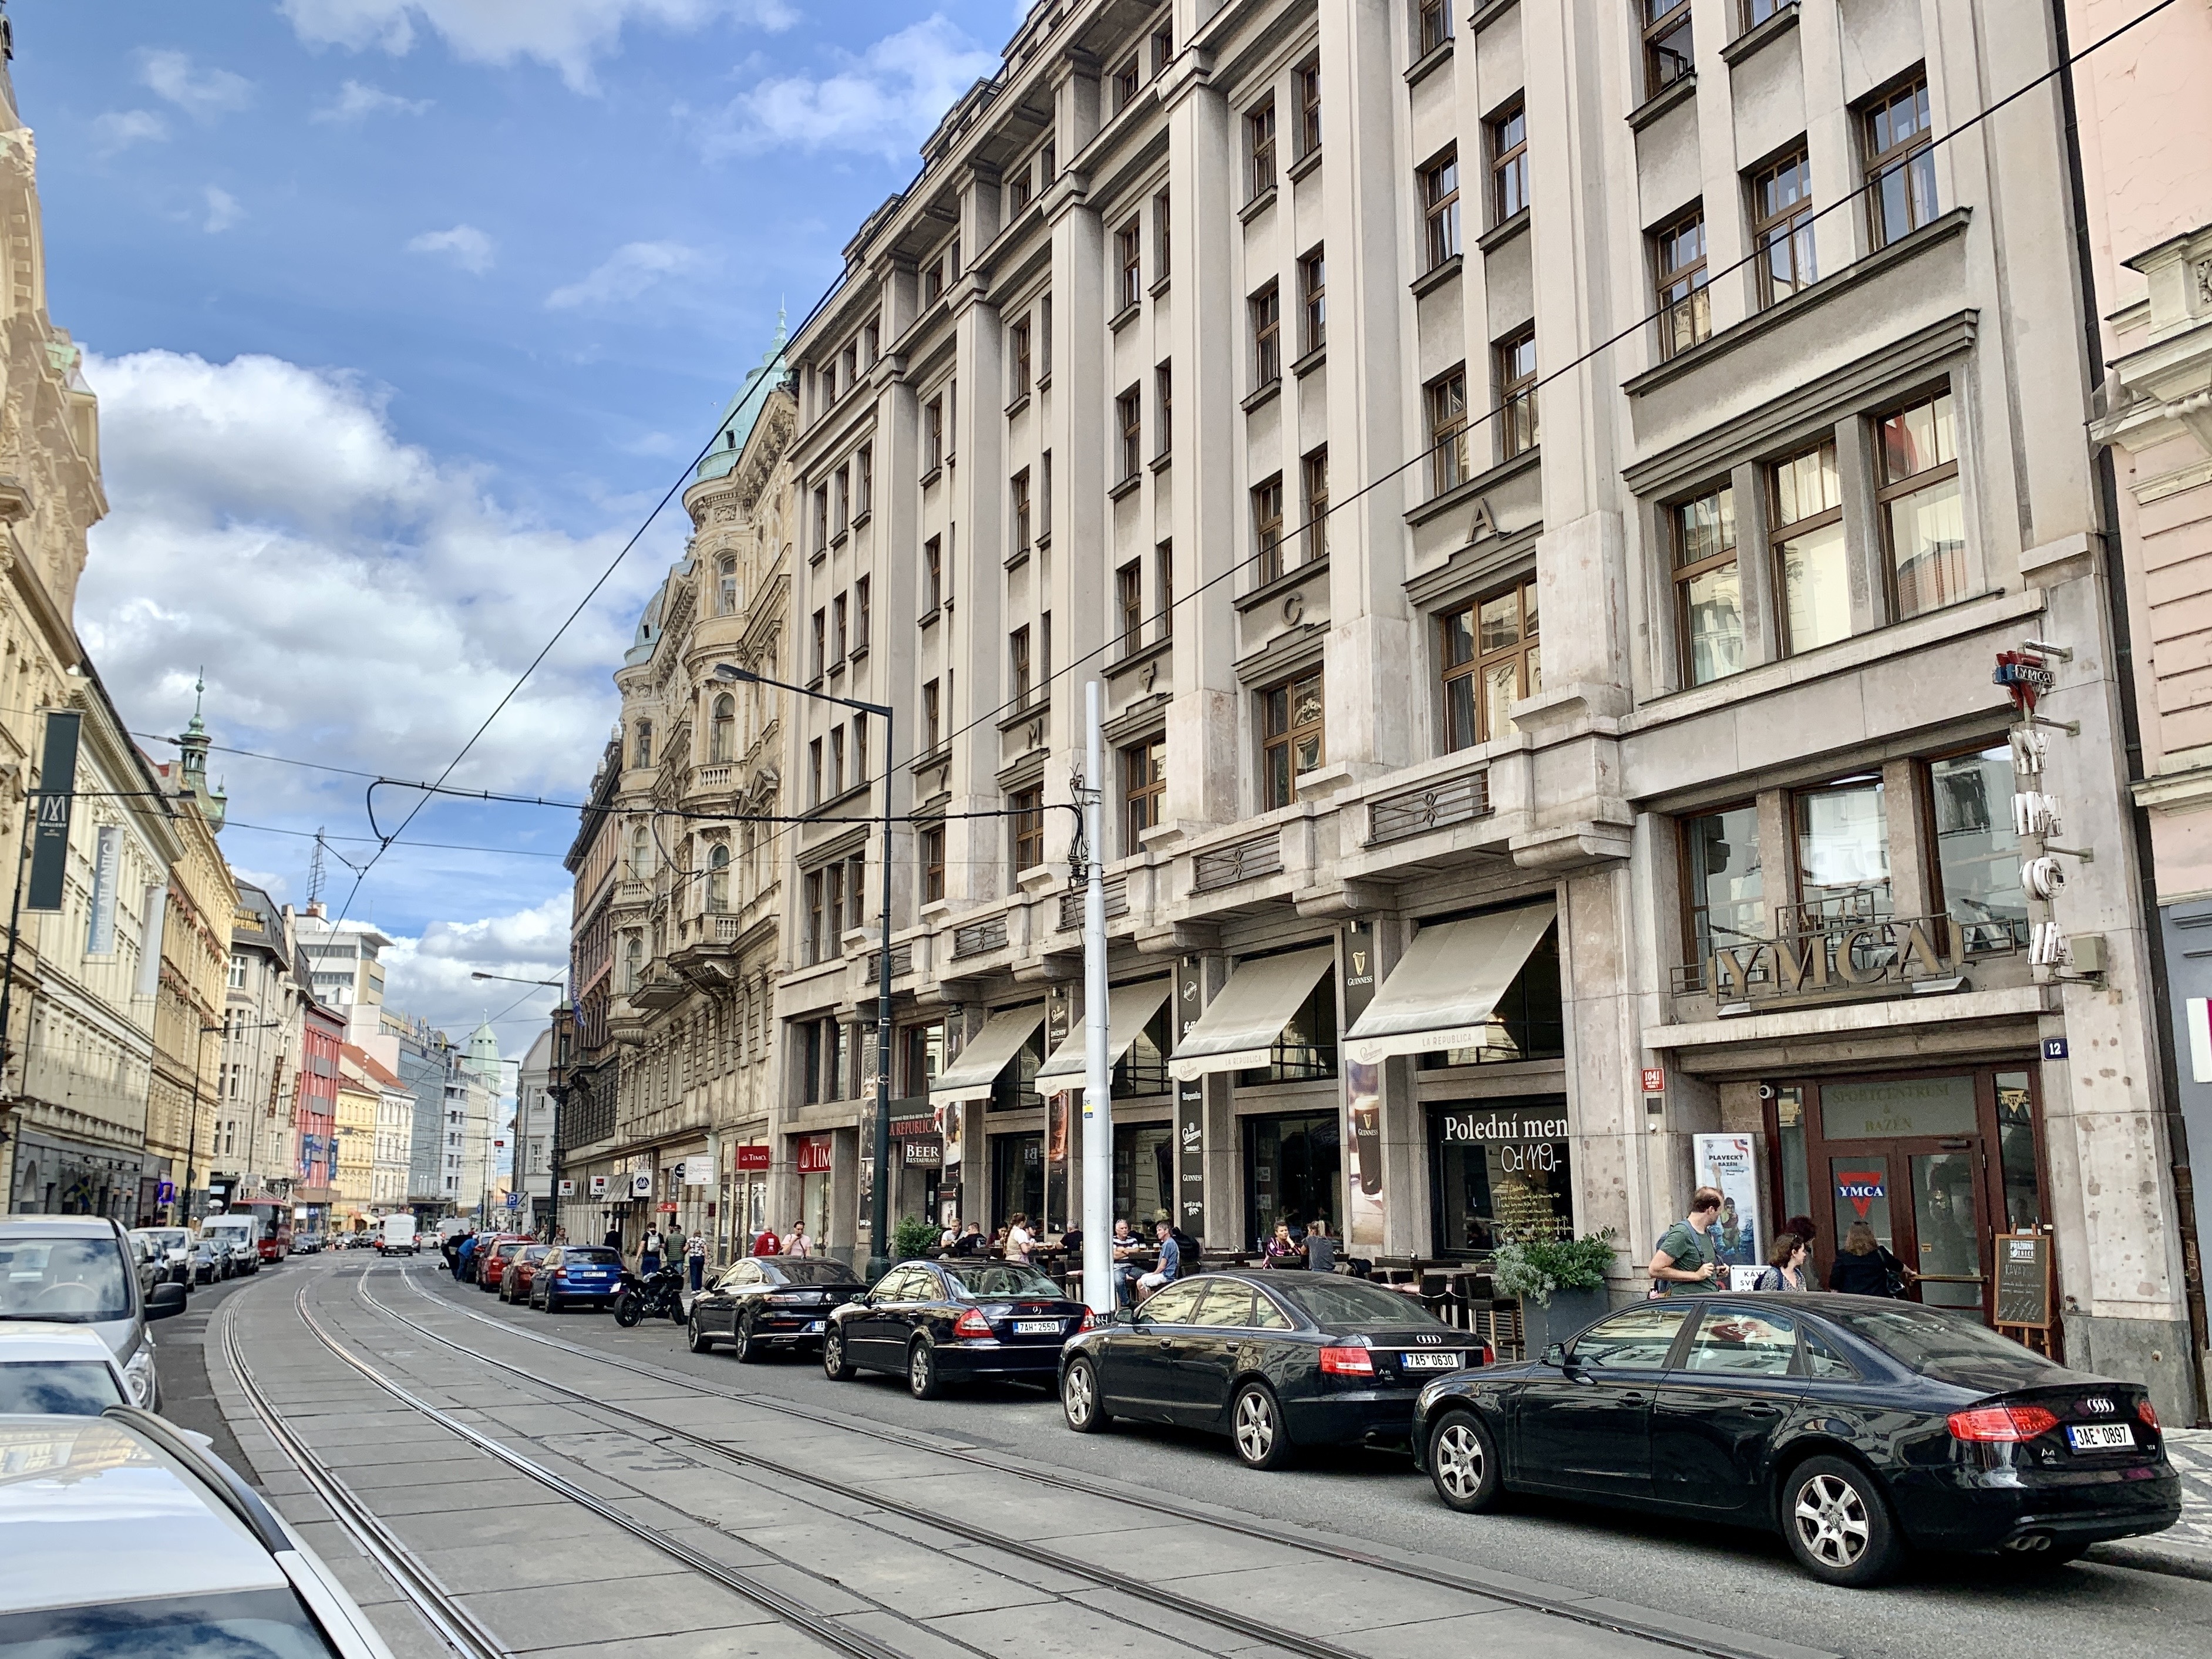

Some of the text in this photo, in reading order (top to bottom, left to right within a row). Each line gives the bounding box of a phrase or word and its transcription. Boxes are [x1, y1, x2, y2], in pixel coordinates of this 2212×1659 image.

[2018, 665, 2053, 685] YMCA
[1718, 921, 1951, 998] YMCA
[1347, 975, 1373, 987] GUINNESS
[1422, 1033, 1472, 1047] LA REPUBLICA
[2049, 1042, 2062, 1056] 12
[1233, 1055, 1262, 1066] REPUBLICA
[1644, 1071, 1660, 1081] 1041
[1831, 1083, 1950, 1103] SPORTCENTRUM
[1358, 1128, 1379, 1136] GUINNESS
[1444, 1113, 1570, 1140] Polední men
[812, 1143, 831, 1167] TIM
[905, 1145, 940, 1157] BEER
[1501, 1145, 1524, 1173] Od
[1182, 1173, 1203, 1182] GUINNESS
[1838, 1186, 1883, 1197] YMCA
[509, 1194, 517, 1204] P
[1019, 1323, 1056, 1331] 7AH 2550
[1408, 1354, 1455, 1367] 7A5 0630
[2076, 1425, 2127, 1446] 3AE 0897
[2041, 1448, 2056, 1457] A4
